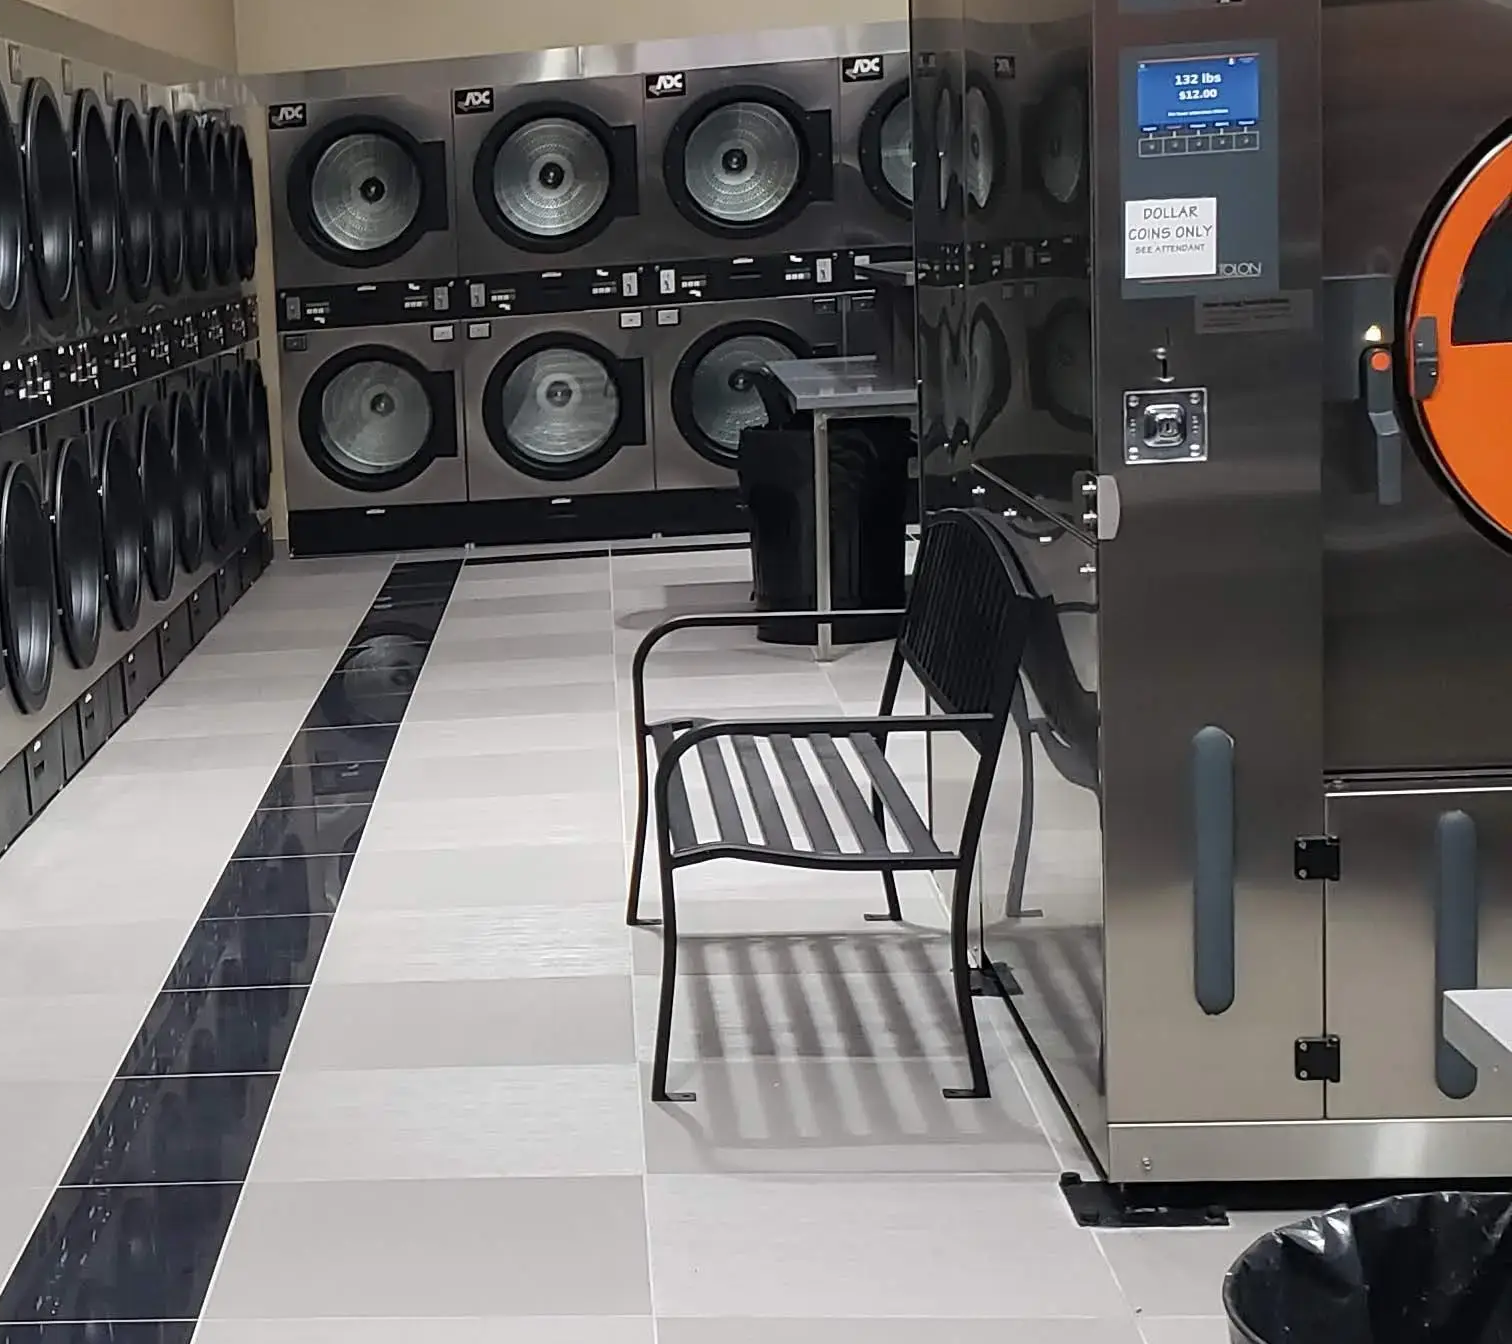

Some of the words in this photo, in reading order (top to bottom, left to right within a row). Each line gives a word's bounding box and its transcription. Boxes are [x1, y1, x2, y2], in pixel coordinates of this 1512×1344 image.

[853, 57, 880, 74] ADC
[656, 74, 683, 90] ADC
[1174, 74, 1199, 86] 132
[1201, 72, 1222, 84] lbs
[464, 90, 491, 106] ADC
[1178, 88, 1218, 101] $12.00
[279, 105, 304, 121] ADC
[1143, 206, 1198, 220] DOLLAR
[1128, 227, 1171, 241] COINS
[1175, 225, 1213, 238] ONLY
[1135, 245, 1153, 254] SEE
[1155, 243, 1205, 253] ATTENDANT
